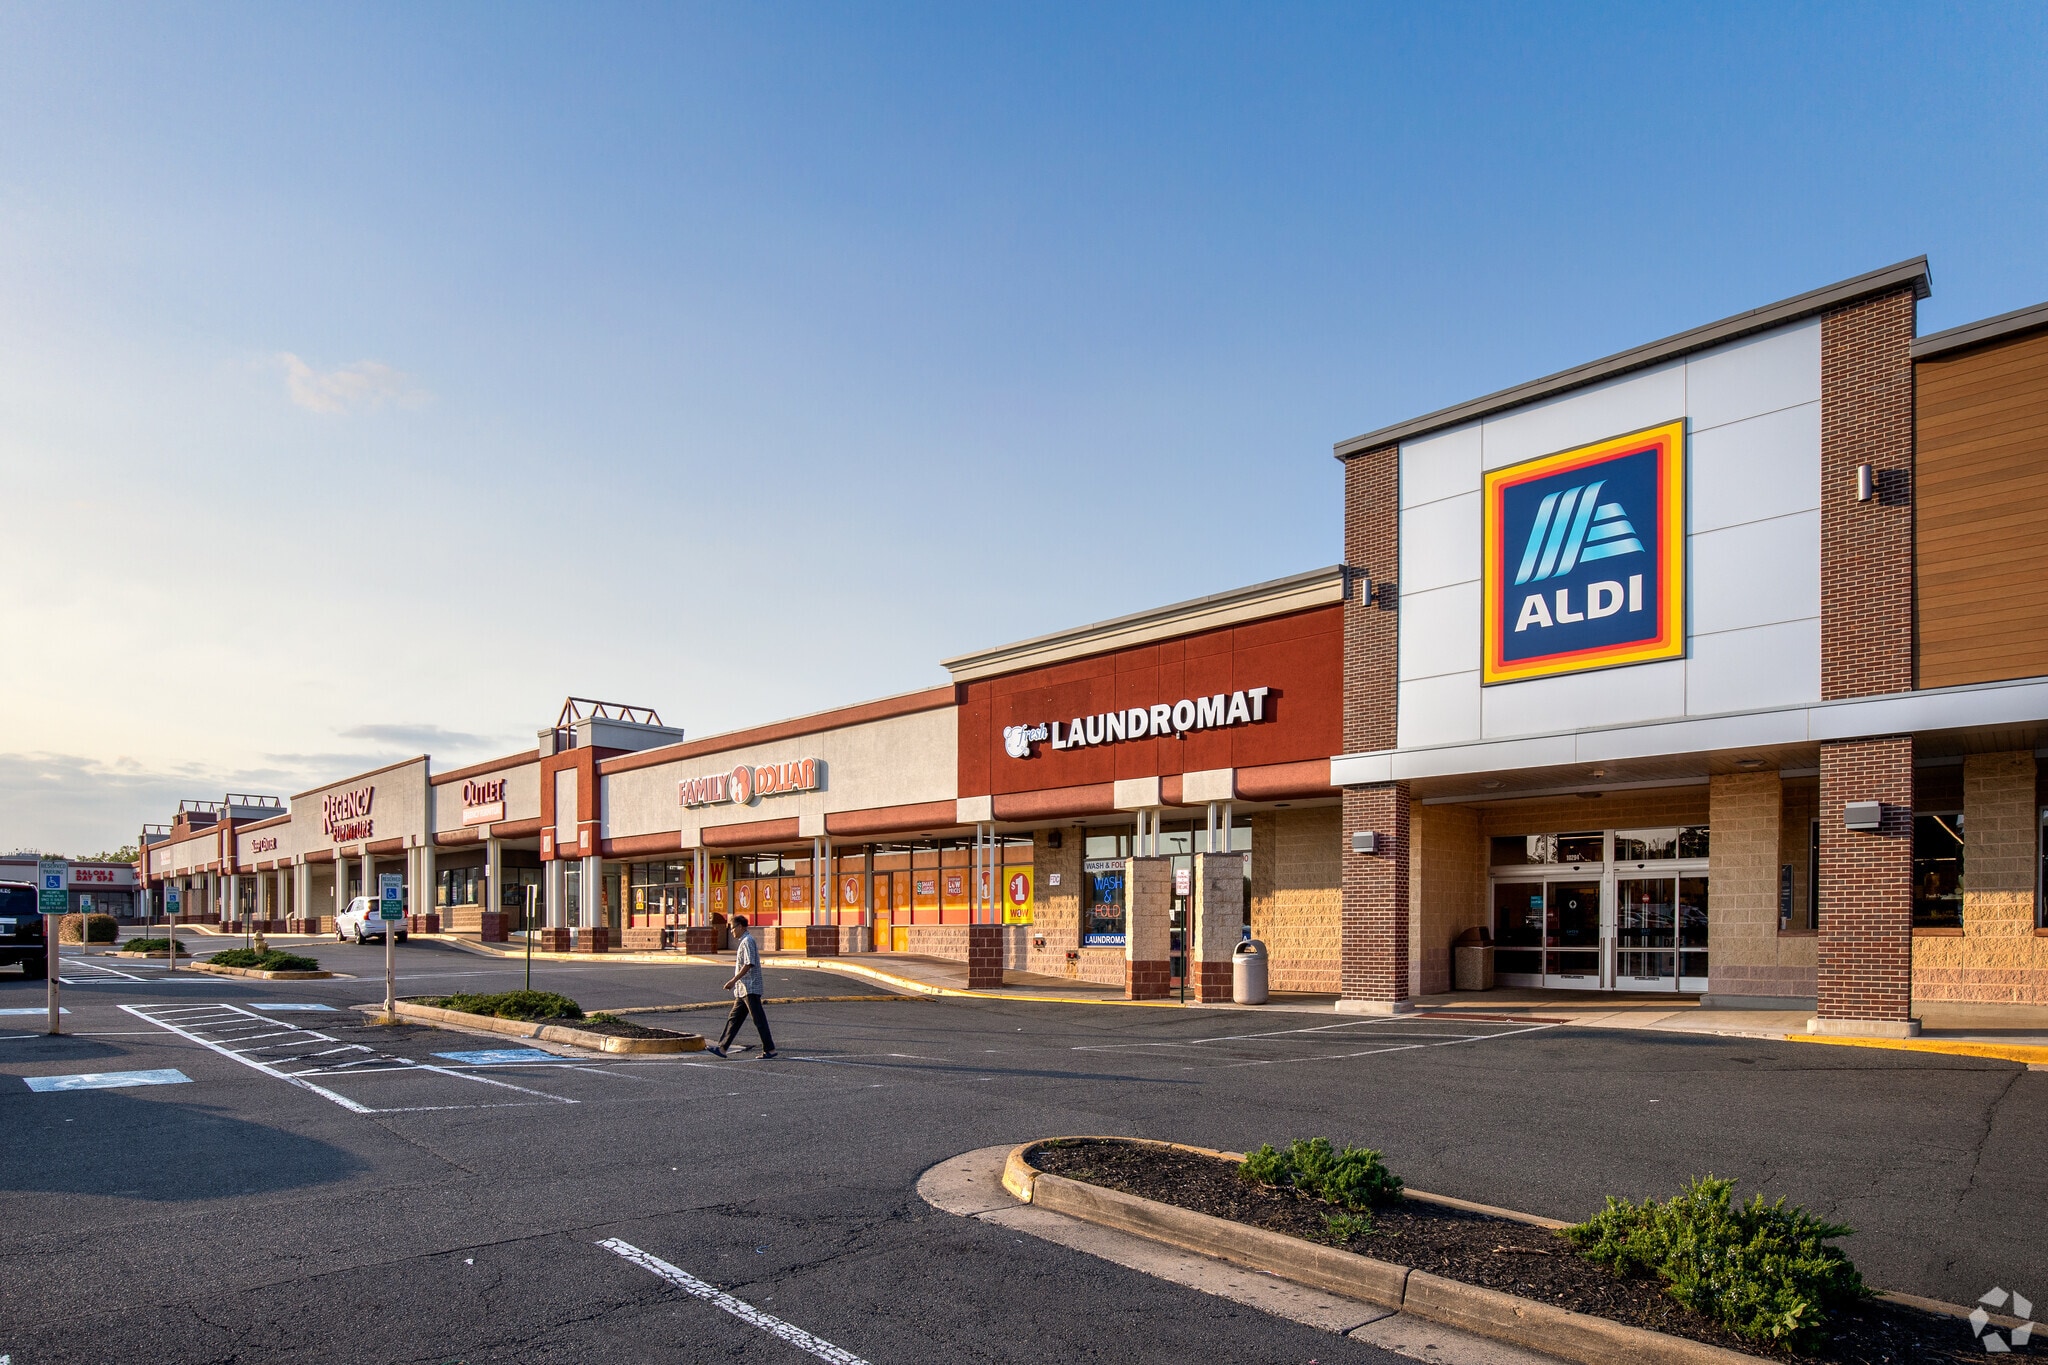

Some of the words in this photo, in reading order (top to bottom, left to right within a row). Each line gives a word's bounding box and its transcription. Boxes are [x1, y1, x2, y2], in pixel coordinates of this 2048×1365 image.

[1514, 574, 1642, 632] ALDI
[1016, 723, 1048, 748] fresh
[1052, 686, 1268, 750] LAUNDROMAT
[462, 778, 505, 806] OUTLET
[679, 772, 730, 806] FAMILY
[754, 758, 816, 796] DOLLAR
[322, 786, 374, 835] REGENCY
[333, 820, 373, 843] FURNITURE
[1011, 876, 1025, 900] $1
[1094, 876, 1122, 890] WASH
[1104, 890, 1112, 904] &
[1095, 904, 1121, 918] FOLD
